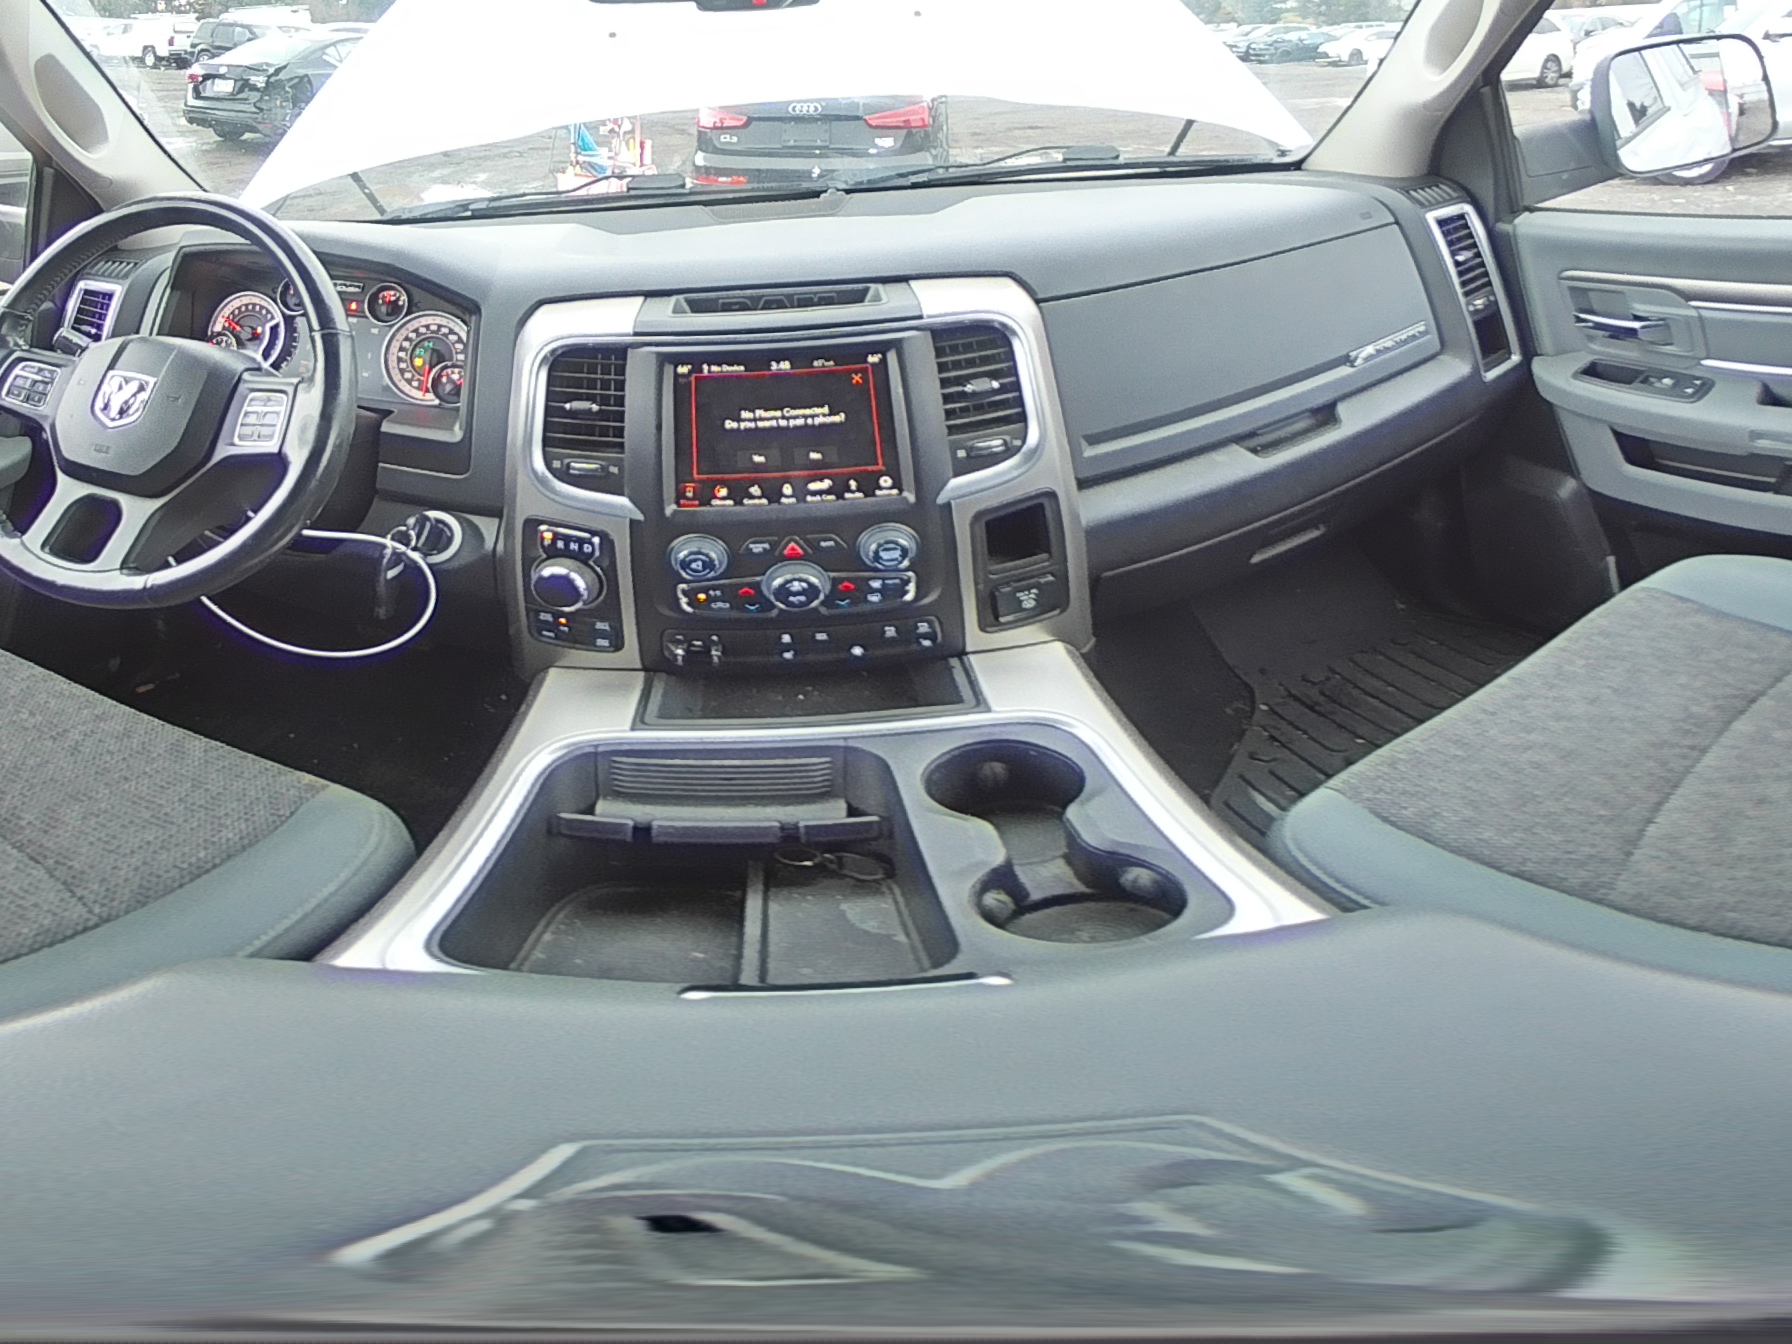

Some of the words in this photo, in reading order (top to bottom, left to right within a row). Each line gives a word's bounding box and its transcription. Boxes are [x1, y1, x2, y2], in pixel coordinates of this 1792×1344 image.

[740, 410, 754, 419] No
[755, 408, 782, 418] Phone
[783, 404, 830, 417] Connected
[724, 419, 739, 430] Do
[739, 420, 756, 431] you
[756, 418, 778, 428] want
[789, 416, 806, 428] pair
[813, 412, 846, 426] phone?
